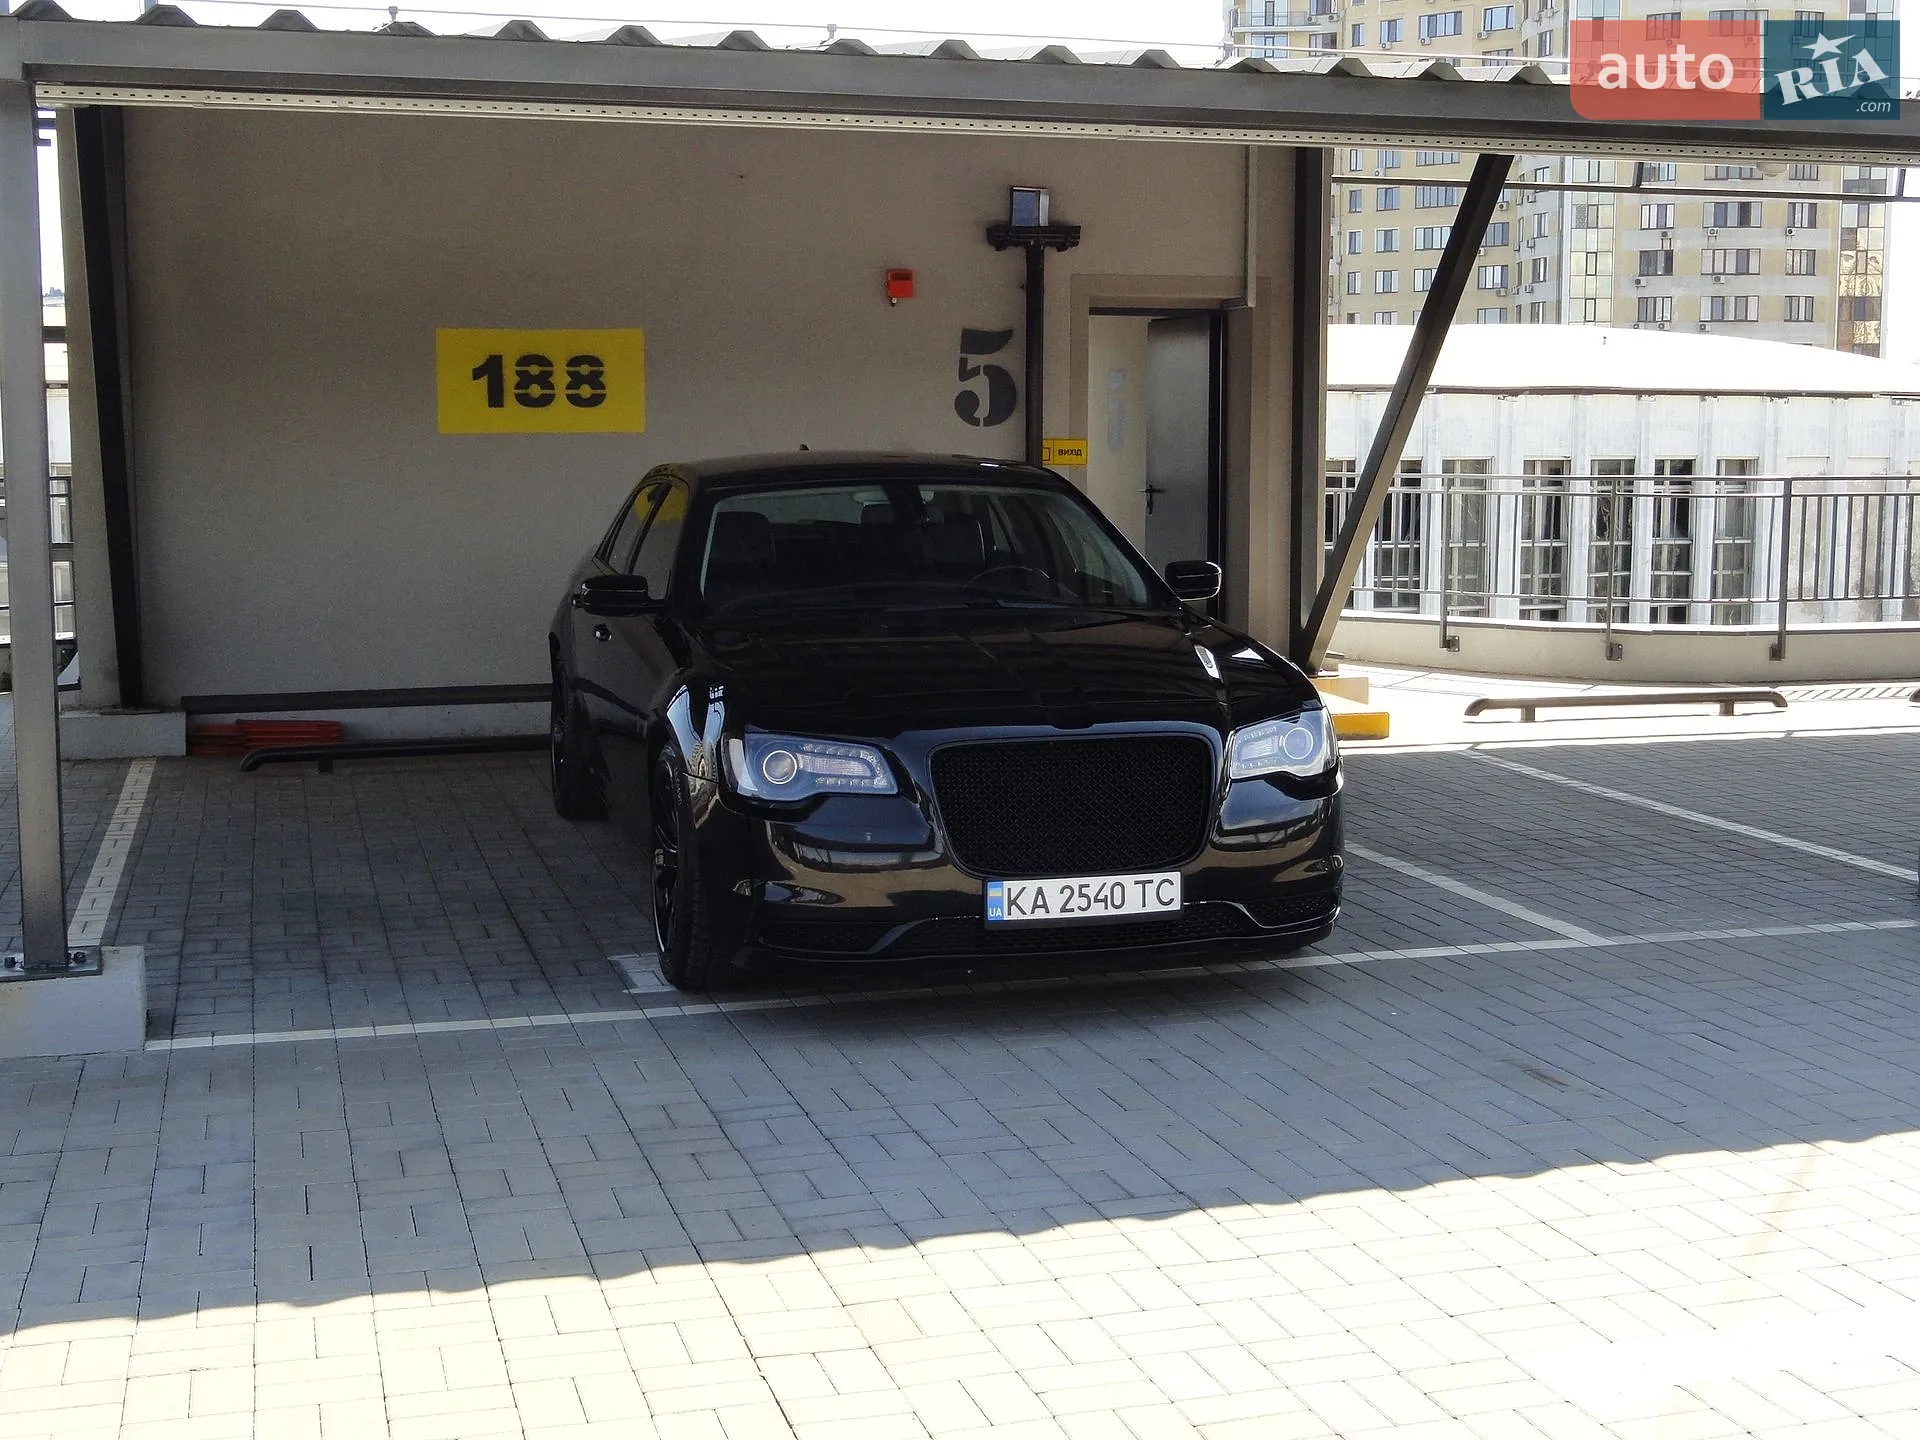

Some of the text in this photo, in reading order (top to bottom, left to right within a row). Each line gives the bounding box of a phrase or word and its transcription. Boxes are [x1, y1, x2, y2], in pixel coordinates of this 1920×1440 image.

[472, 354, 607, 408] 188
[954, 328, 1017, 427] 5
[989, 907, 1003, 918] UA
[1007, 878, 1175, 916] KA 2540 TC
